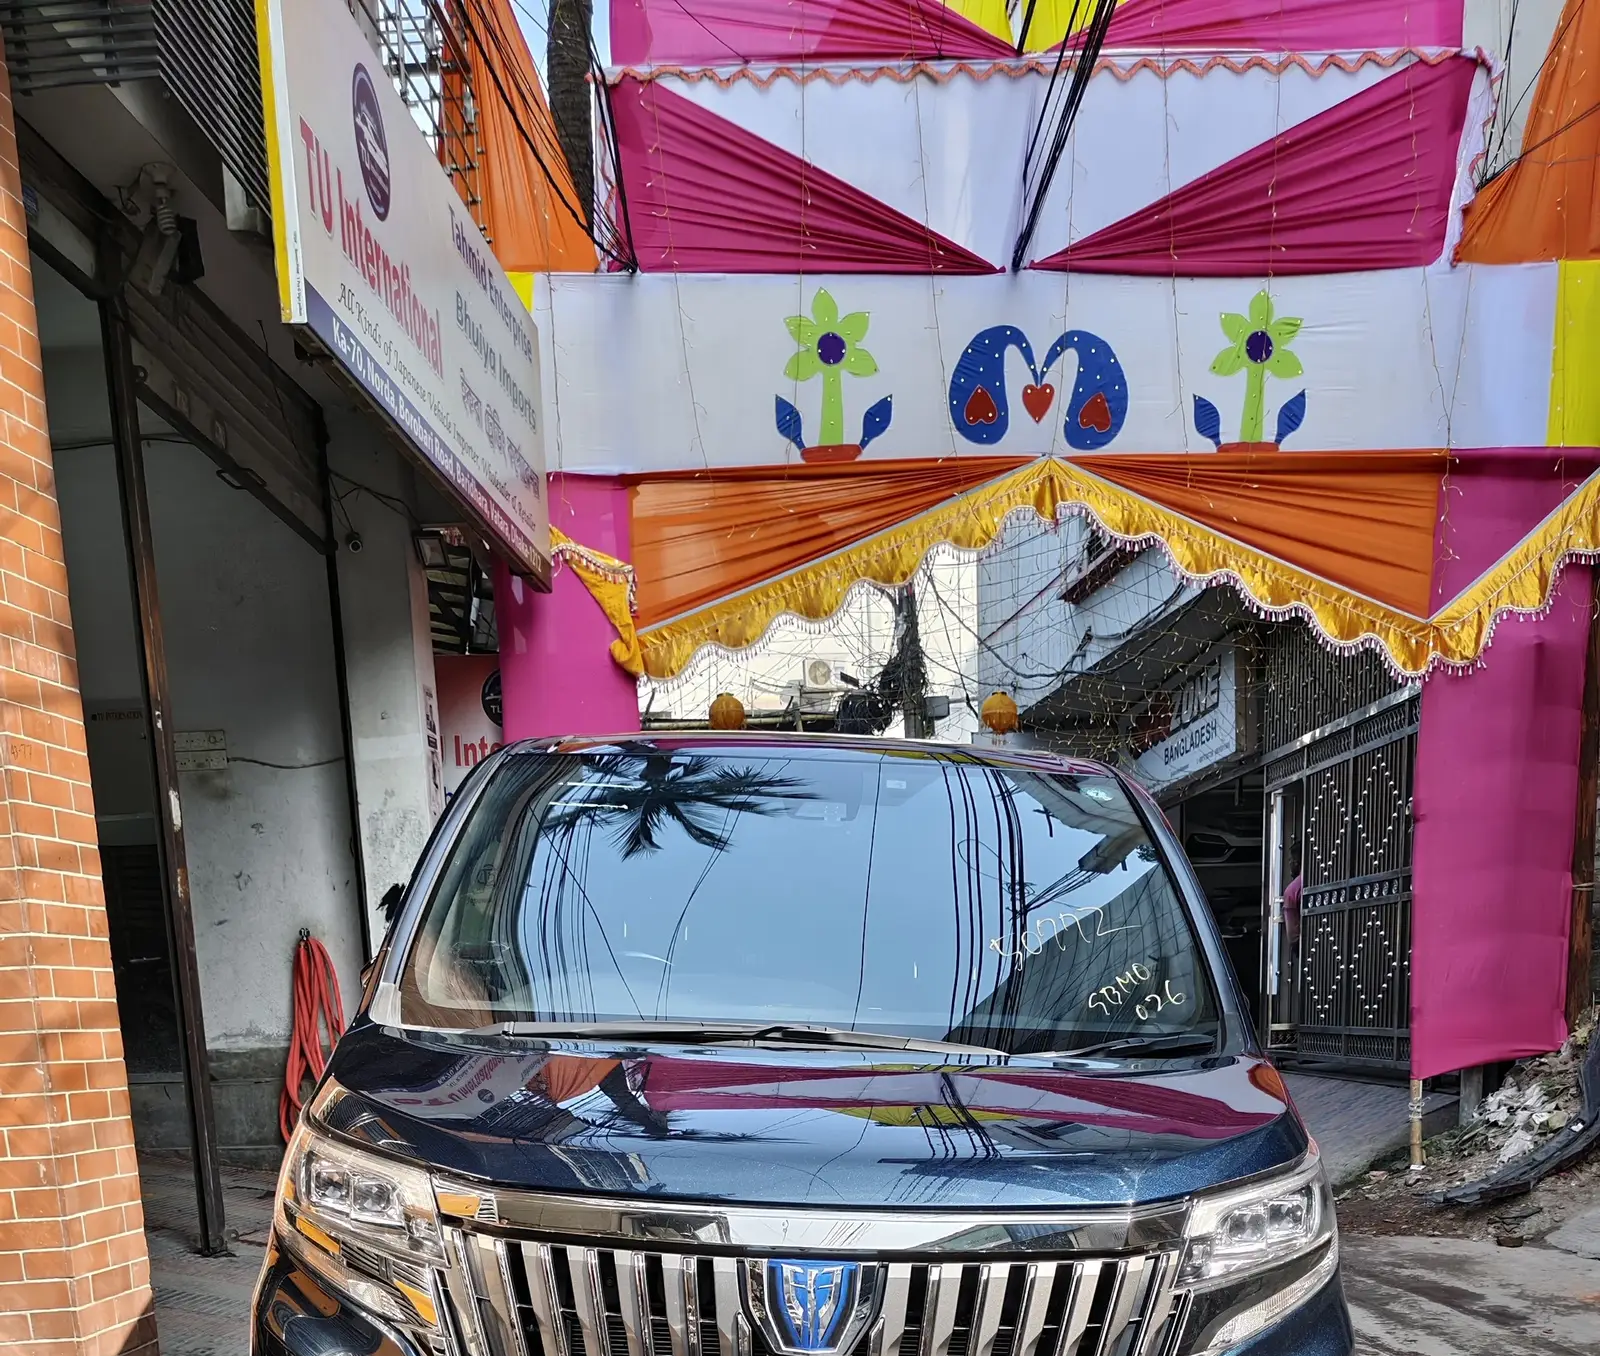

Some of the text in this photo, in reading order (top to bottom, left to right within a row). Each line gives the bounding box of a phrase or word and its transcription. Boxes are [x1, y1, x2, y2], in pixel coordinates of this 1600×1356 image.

[299, 113, 443, 380] TU International
[448, 202, 533, 364] Tahmid Enterprise
[338, 283, 355, 314] All
[356, 302, 382, 348] Kinds
[384, 340, 393, 365] of
[394, 350, 427, 402] Japanese
[456, 290, 537, 432] Bhuiya Imports
[333, 316, 366, 379] Ka-70,
[367, 356, 398, 417] Norda,
[399, 393, 434, 455] Borobari
[434, 436, 456, 481] Road,
[456, 460, 490, 519] Baridhara,
[1164, 718, 1218, 766] BANGLADESH
[1135, 980, 1187, 1021] 026
